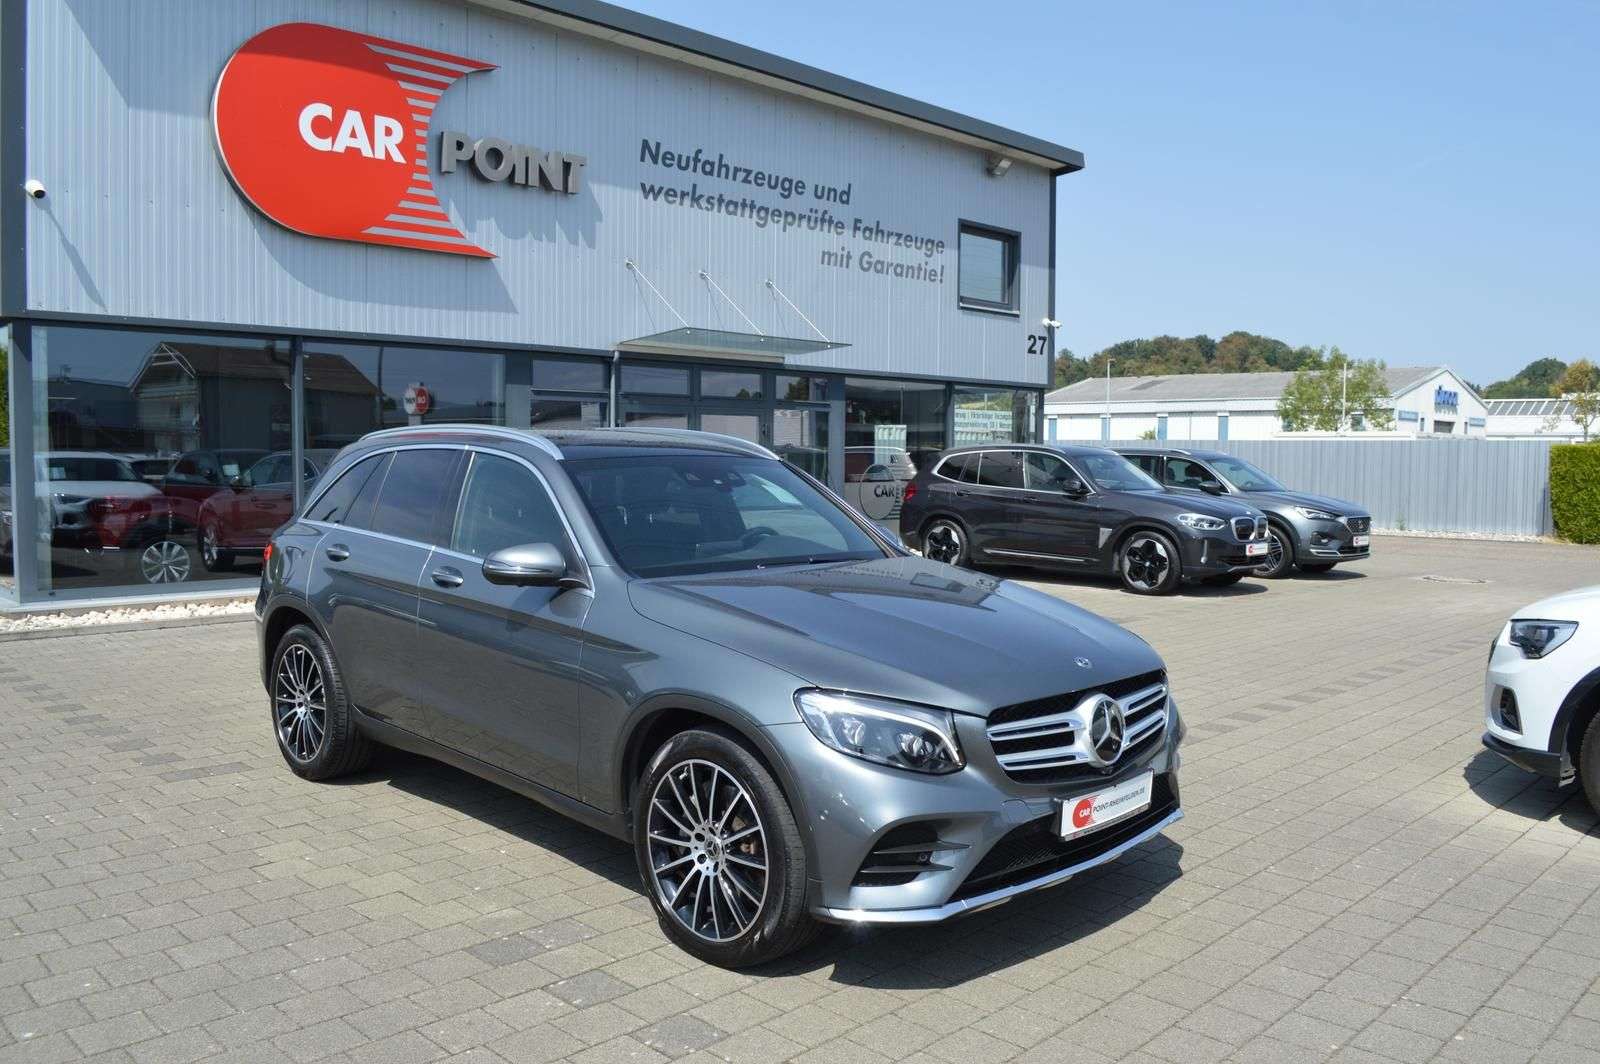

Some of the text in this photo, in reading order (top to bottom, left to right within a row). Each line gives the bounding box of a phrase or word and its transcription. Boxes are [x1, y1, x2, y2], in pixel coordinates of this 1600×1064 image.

[299, 102, 588, 195] CAR POINT
[639, 138, 852, 206] Neufahrzeuge und
[640, 182, 945, 258] werkstattgeprüfte Fahrzeuge
[820, 246, 945, 284] mit Garantie!
[1027, 334, 1048, 356] 27
